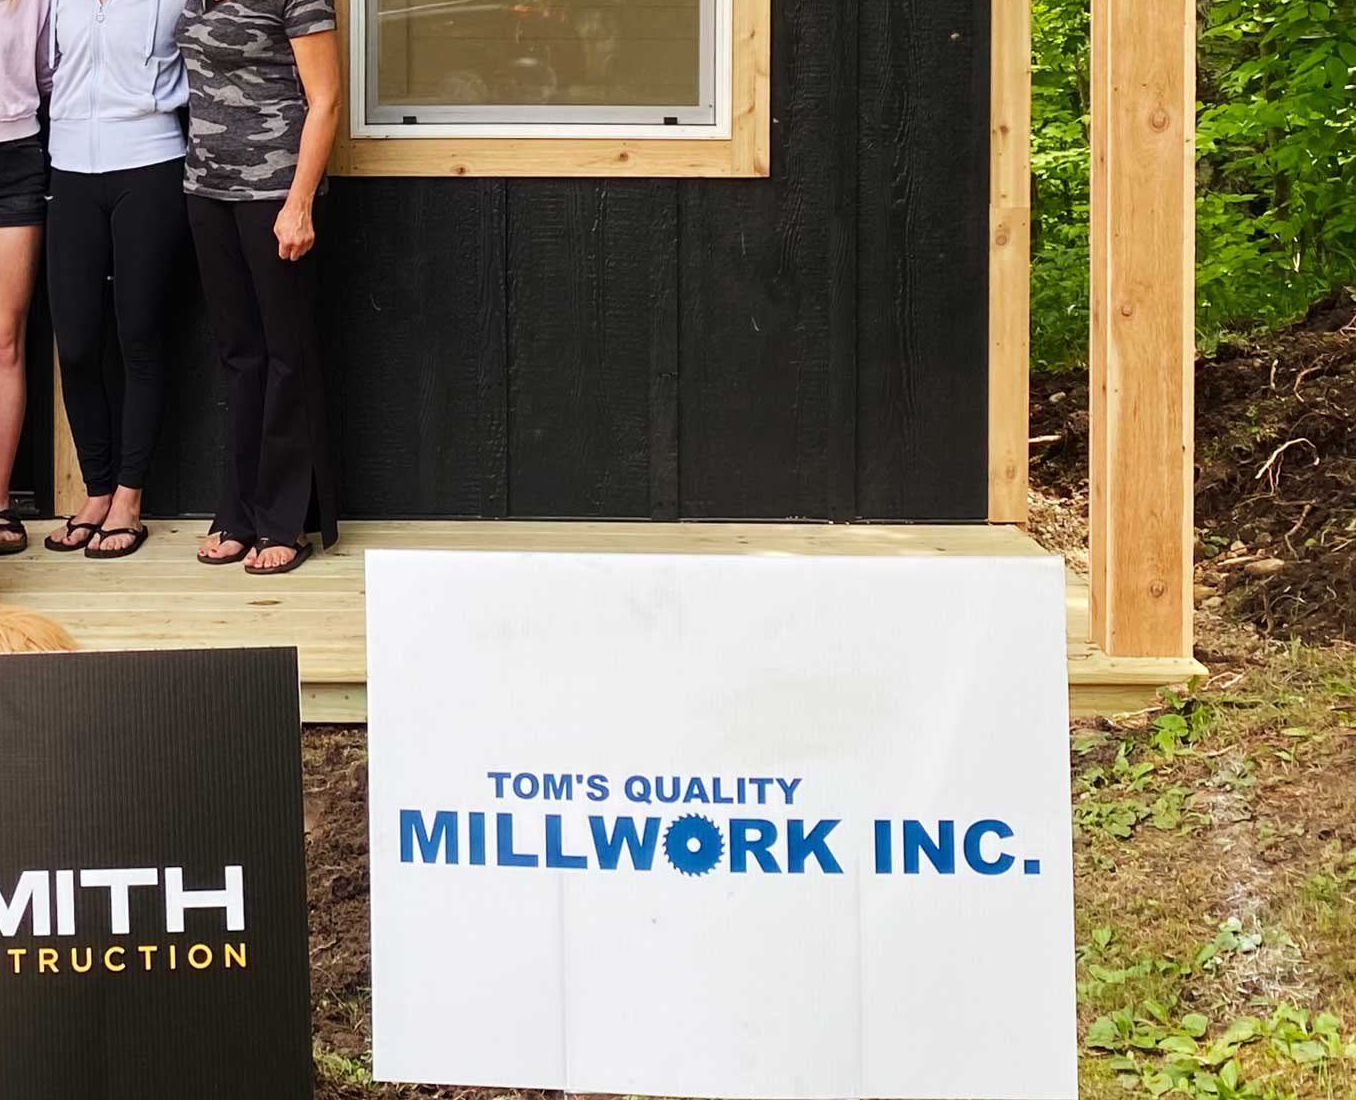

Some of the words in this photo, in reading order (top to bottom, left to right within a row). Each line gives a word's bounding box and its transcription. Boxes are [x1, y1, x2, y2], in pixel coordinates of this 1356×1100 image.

[487, 772, 610, 801] TOM'S
[624, 776, 803, 804] QUALITY
[399, 809, 844, 878] MILLWORK
[874, 819, 1041, 876] INC.
